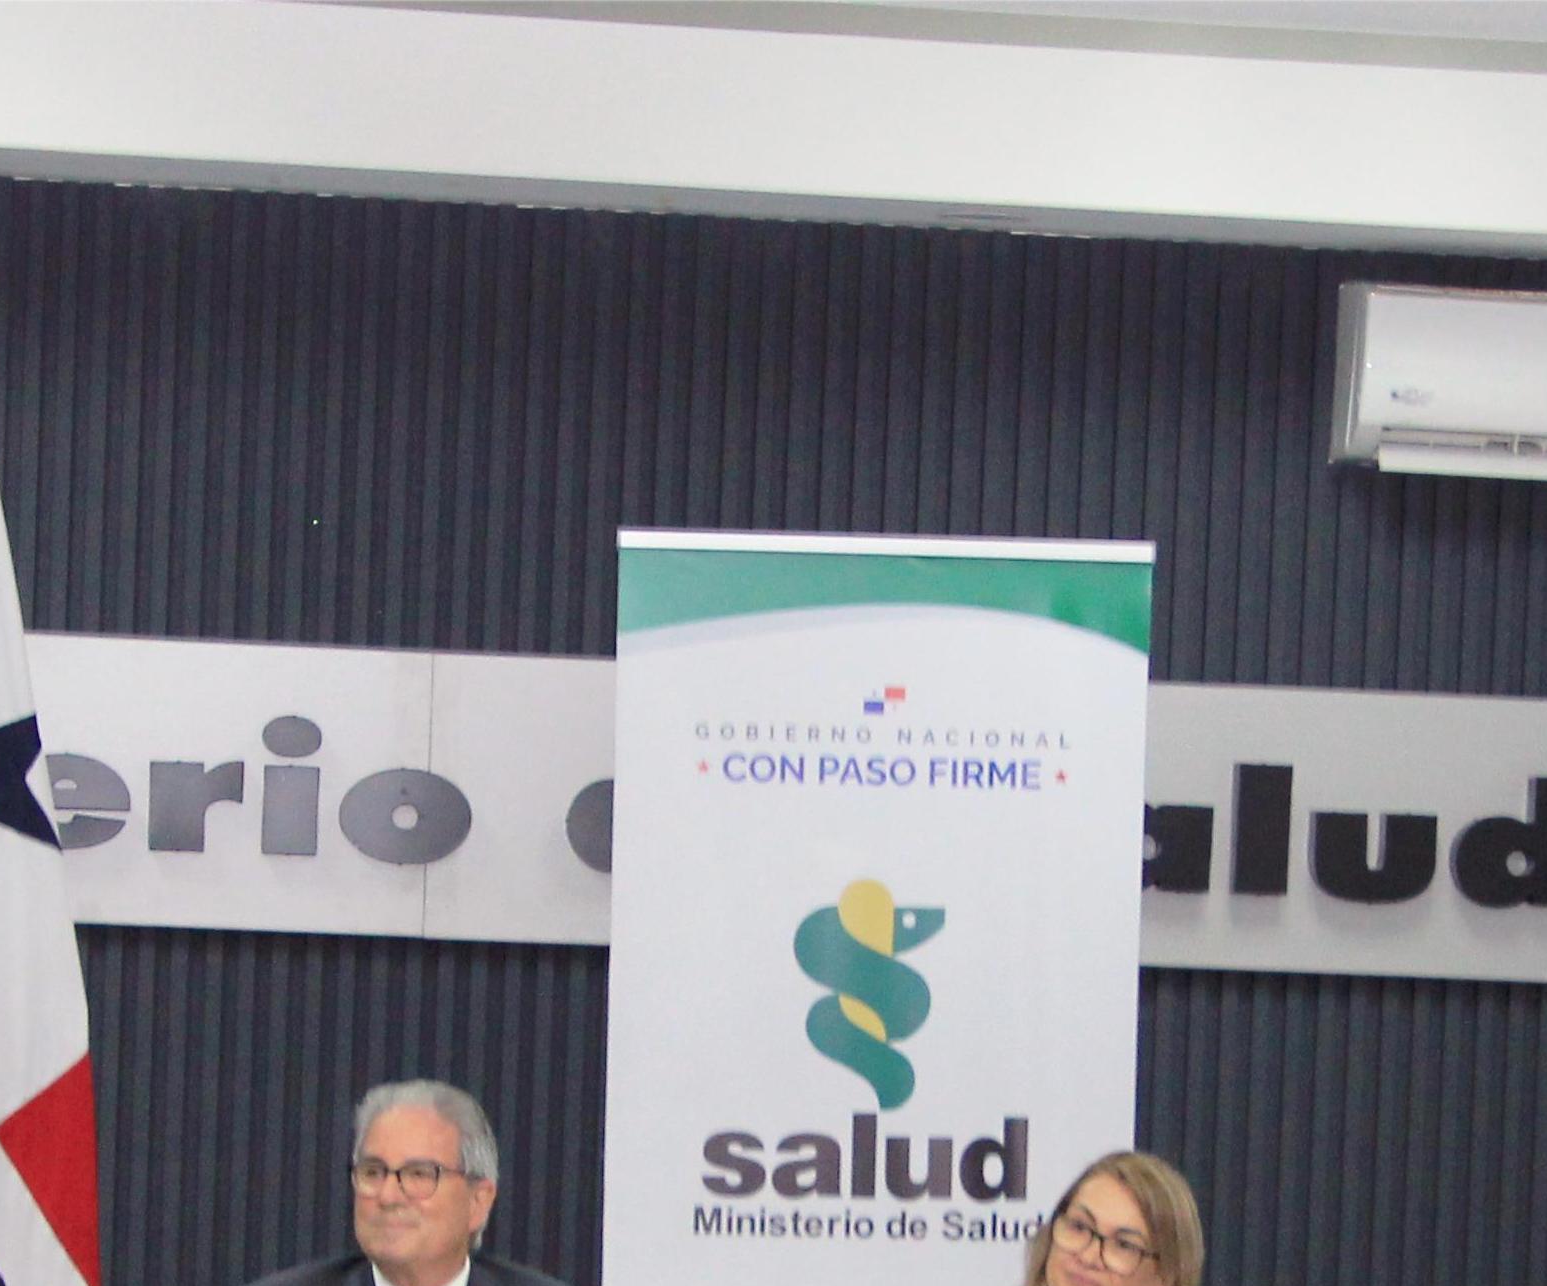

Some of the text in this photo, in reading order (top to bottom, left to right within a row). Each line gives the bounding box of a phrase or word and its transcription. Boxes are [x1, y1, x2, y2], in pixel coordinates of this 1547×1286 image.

[695, 724, 1071, 749] GOBIERNO NACIONAL
[722, 753, 1042, 790] CON PASO FIRME
[701, 1113, 1029, 1203] salud
[693, 1206, 1044, 1242] Ministerio de Salud
